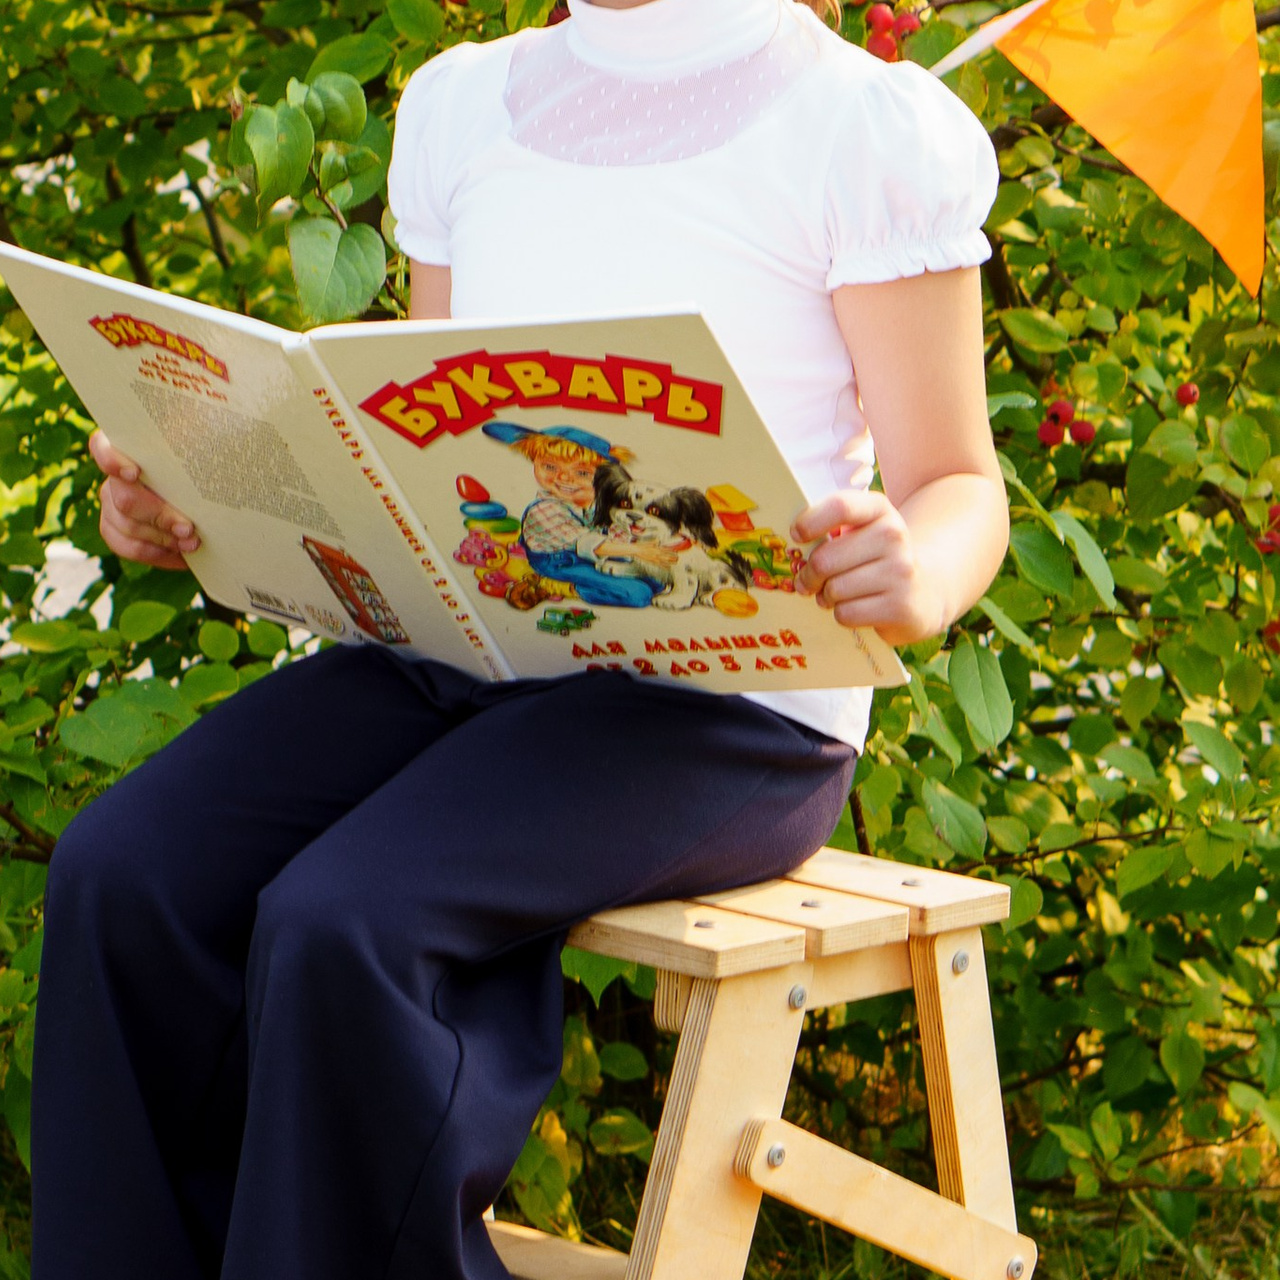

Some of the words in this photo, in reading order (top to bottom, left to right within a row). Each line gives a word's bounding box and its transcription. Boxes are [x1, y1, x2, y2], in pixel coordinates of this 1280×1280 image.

[312, 387, 365, 461] БУКВАРЬ
[378, 360, 710, 439] БУКВАРЬ
[632, 657, 659, 677] 2
